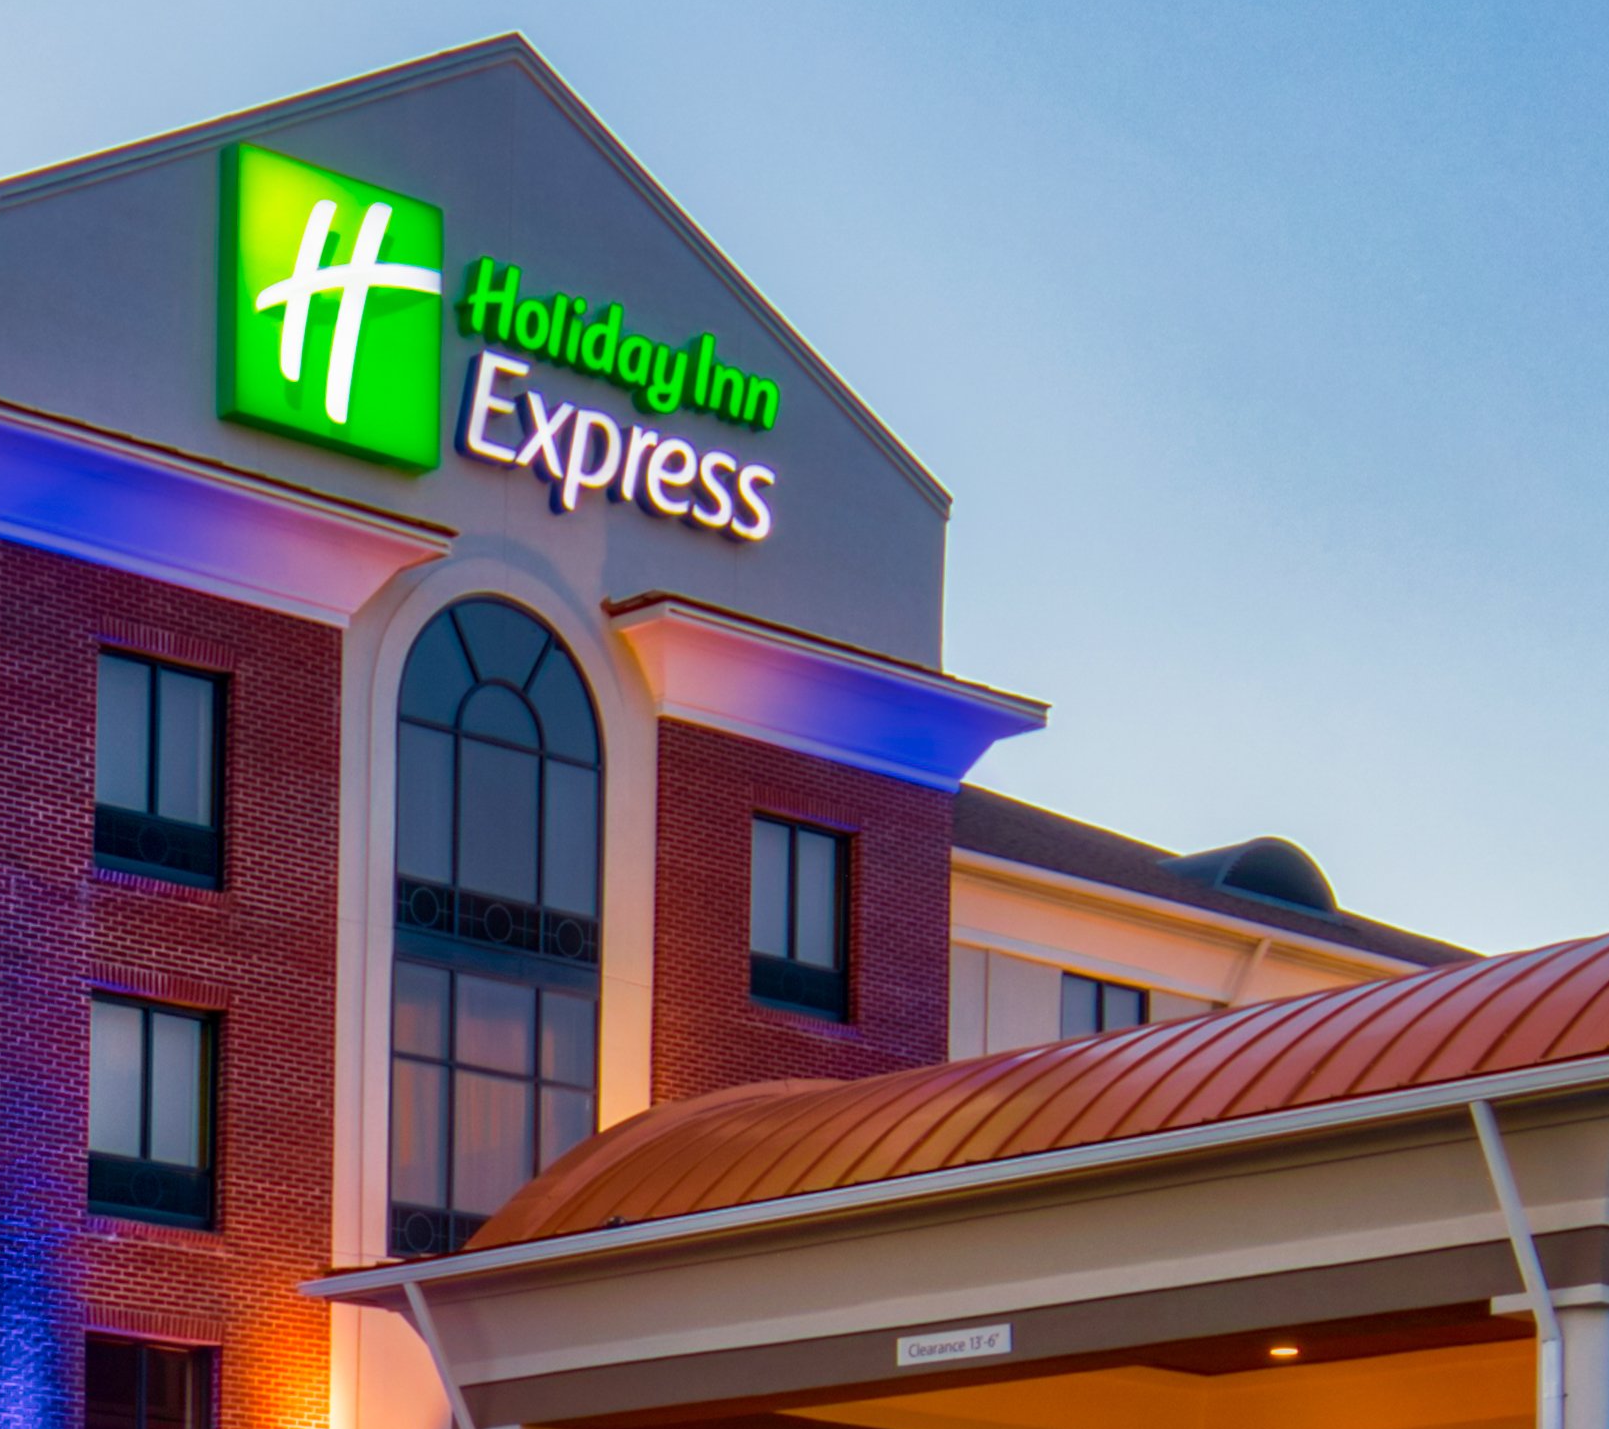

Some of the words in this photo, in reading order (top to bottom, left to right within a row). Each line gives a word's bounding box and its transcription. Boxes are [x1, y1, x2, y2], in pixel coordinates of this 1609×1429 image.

[466, 255, 689, 414] Holiday
[693, 332, 781, 431] Inn
[466, 349, 777, 541] Express
[908, 1341, 966, 1358] Clearance
